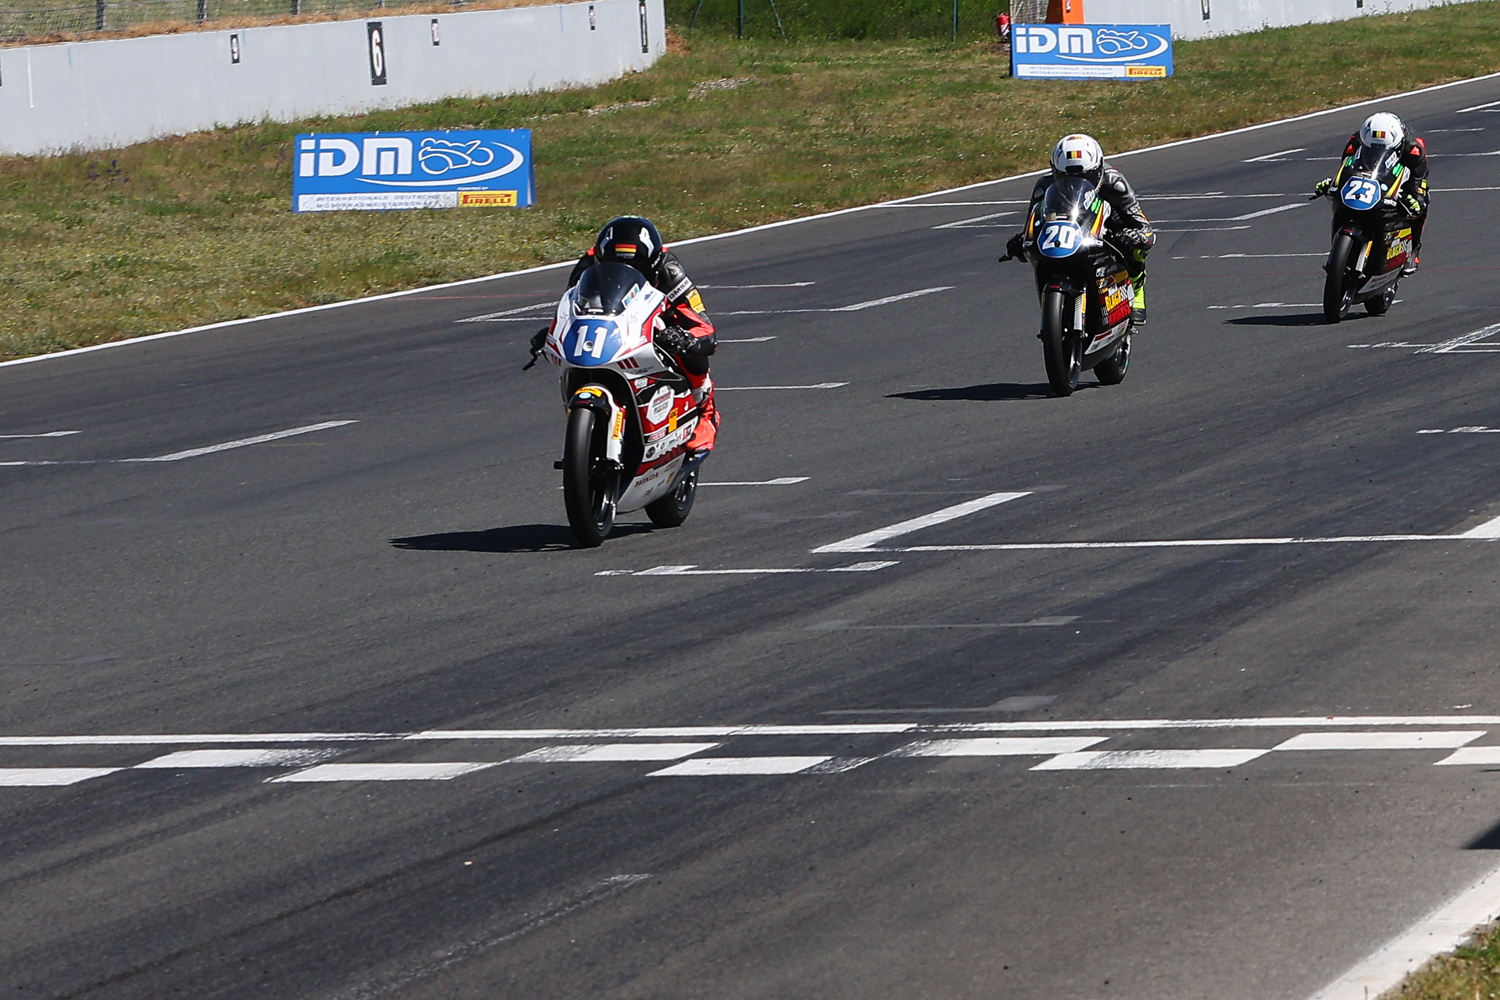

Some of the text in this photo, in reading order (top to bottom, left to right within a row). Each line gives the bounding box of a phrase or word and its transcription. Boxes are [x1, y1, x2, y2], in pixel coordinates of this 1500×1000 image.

[371, 29, 383, 77] 6
[1128, 68, 1163, 76] PIRELLI
[463, 193, 512, 204] PIRELLI
[1345, 180, 1376, 204] 23
[1042, 225, 1076, 250] 20
[573, 325, 608, 359] 11
